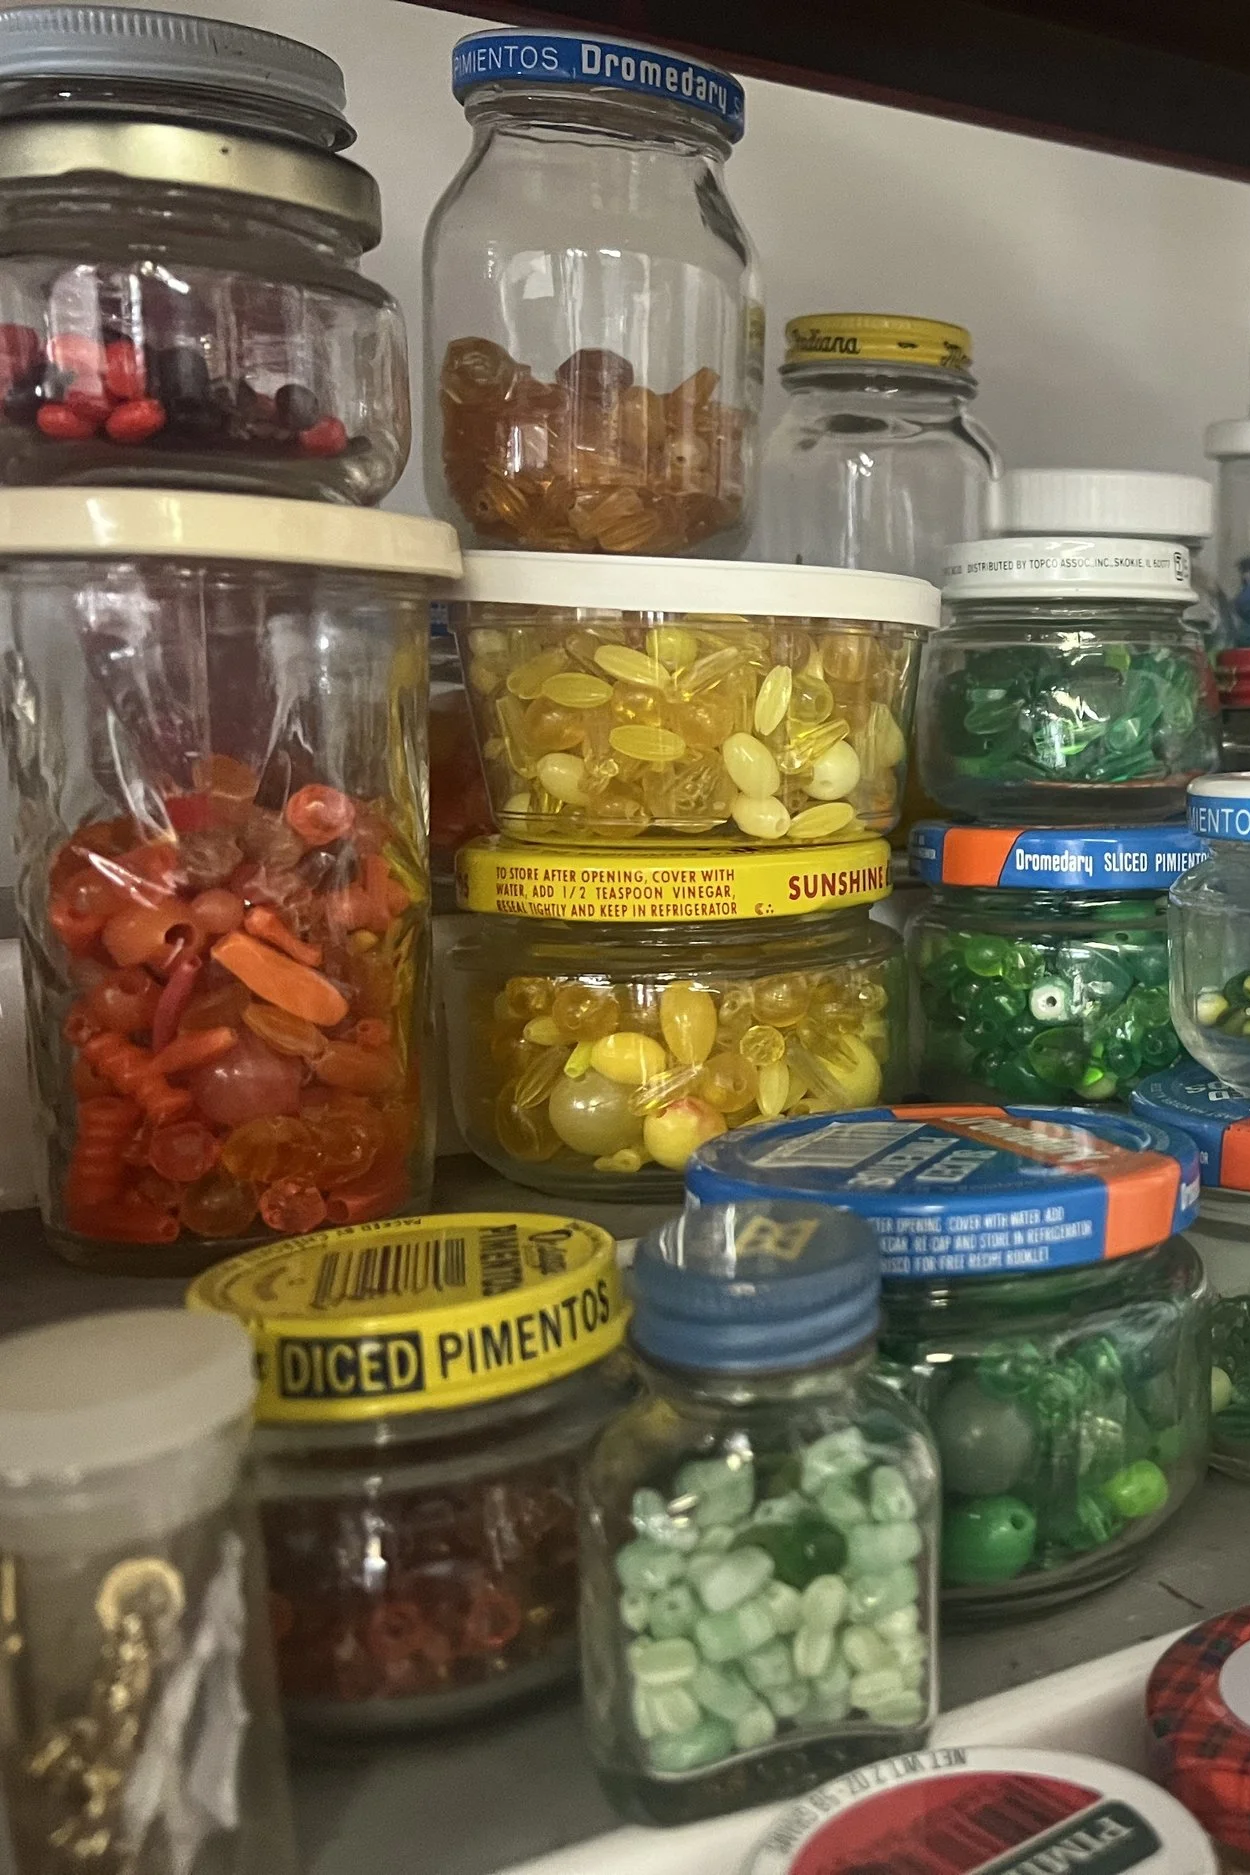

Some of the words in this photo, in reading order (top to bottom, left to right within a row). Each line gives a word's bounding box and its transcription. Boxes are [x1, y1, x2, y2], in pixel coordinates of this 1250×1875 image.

[581, 43, 727, 115] Dromedary
[967, 561, 1013, 574] DISTRIBUTED
[1016, 560, 1026, 570] BY
[1029, 559, 1058, 569] TOPCO
[1015, 848, 1093, 876] Dromedary
[1104, 852, 1148, 872] SLICED
[496, 867, 507, 880] TO
[509, 867, 539, 881] STORE
[543, 868, 576, 882] AFTER
[581, 869, 648, 885] OPENING,
[652, 869, 697, 883] COVER
[701, 869, 735, 882] WITH
[788, 867, 883, 900] SUNSHINE
[496, 884, 527, 899] WATER,
[532, 885, 554, 899] ADD
[563, 885, 587, 899] 1/2
[595, 885, 663, 900] TEASPOON
[672, 884, 736, 900] VINEGAR,
[496, 900, 526, 915] RESEAL
[528, 901, 566, 918] TIGHTLY
[570, 903, 596, 917] AND
[600, 903, 628, 917] KEEP
[632, 903, 646, 917] IN
[650, 901, 738, 917] REFRIGERATOR
[983, 1212, 1008, 1229] WITH
[1044, 1206, 1065, 1224] ADD
[954, 1233, 978, 1251] AND
[284, 1336, 420, 1394] DICED
[437, 1279, 611, 1380] PIMENTOS
[929, 1748, 967, 1770] NET
